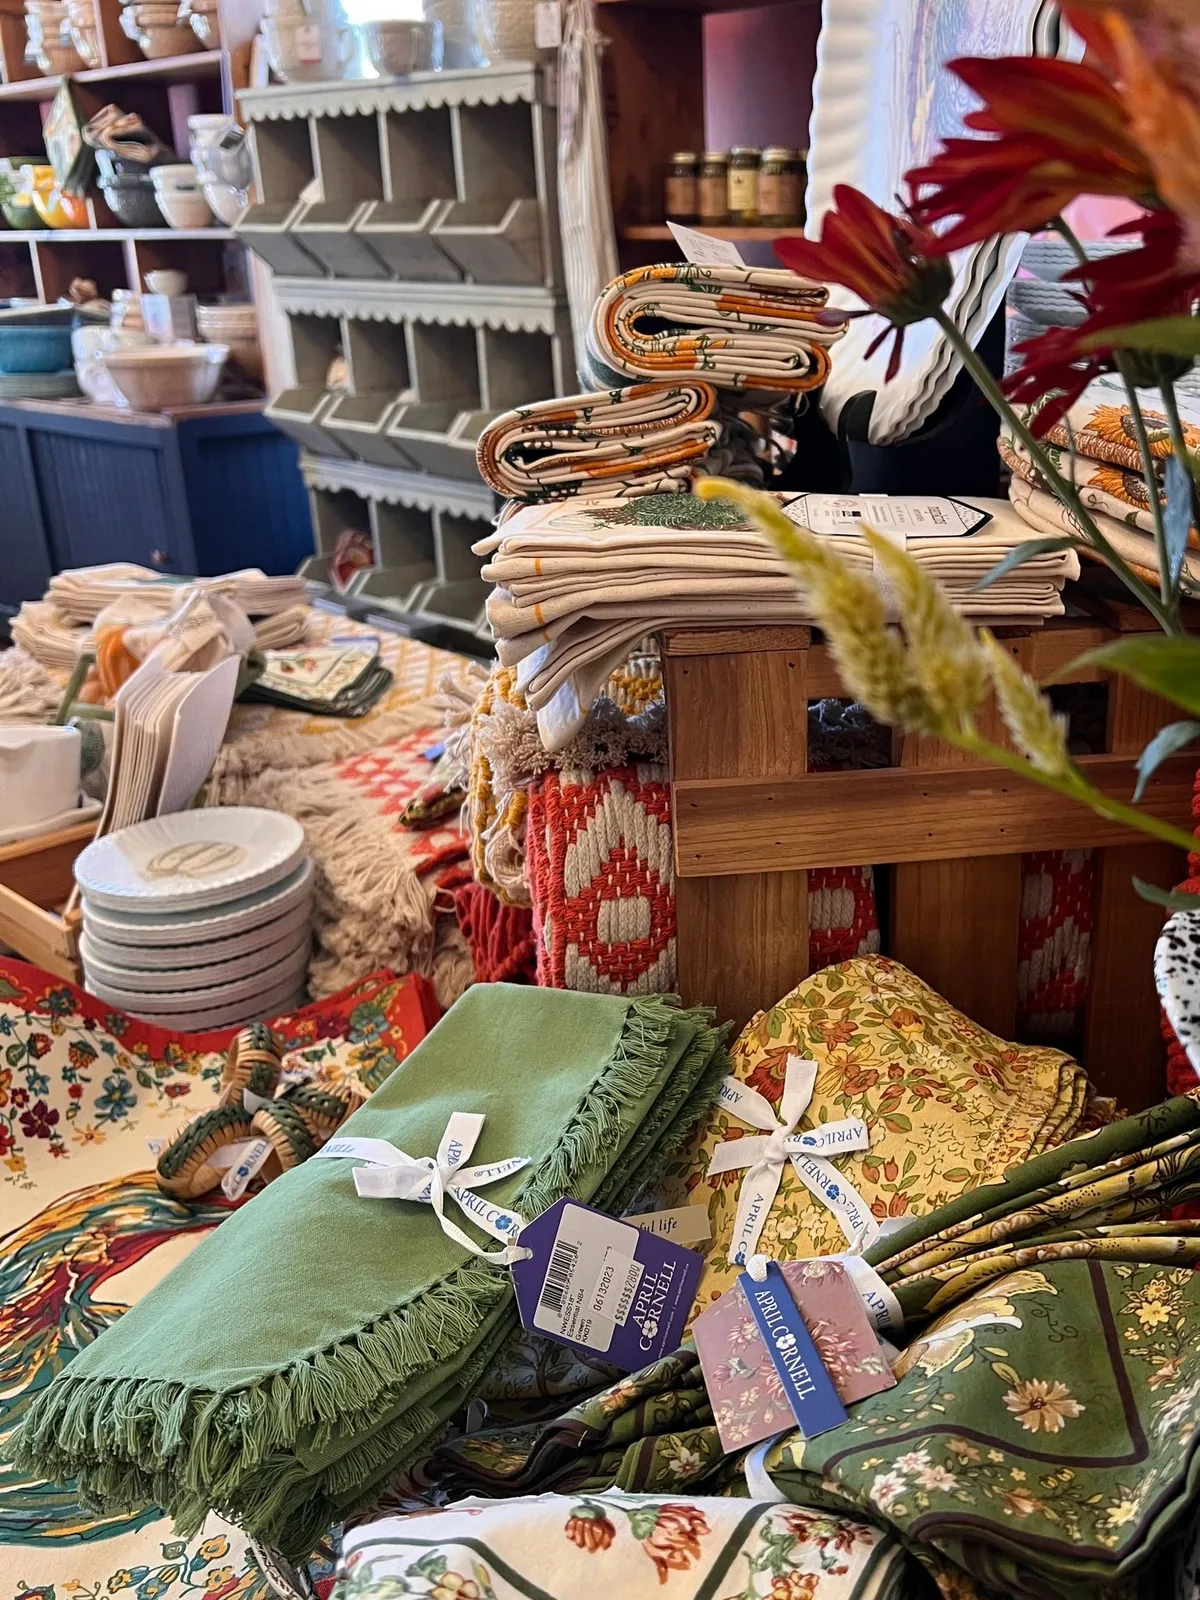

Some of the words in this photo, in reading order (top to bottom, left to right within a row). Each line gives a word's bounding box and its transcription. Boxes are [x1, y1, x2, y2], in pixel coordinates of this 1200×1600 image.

[718, 1084, 743, 1103] APRI
[826, 1126, 863, 1145] APRIL
[453, 1186, 488, 1217] APRIL
[742, 1193, 764, 1237] APRIL
[659, 1217, 678, 1233] life
[593, 1266, 615, 1311] 06132023
[632, 1273, 658, 1328] APRIL
[567, 1305, 581, 1338] Essential
[640, 1261, 677, 1351] CORNELL
[575, 1318, 586, 1341] Green
[754, 1290, 784, 1328] APRIL
[771, 1325, 816, 1400] CORNELL
